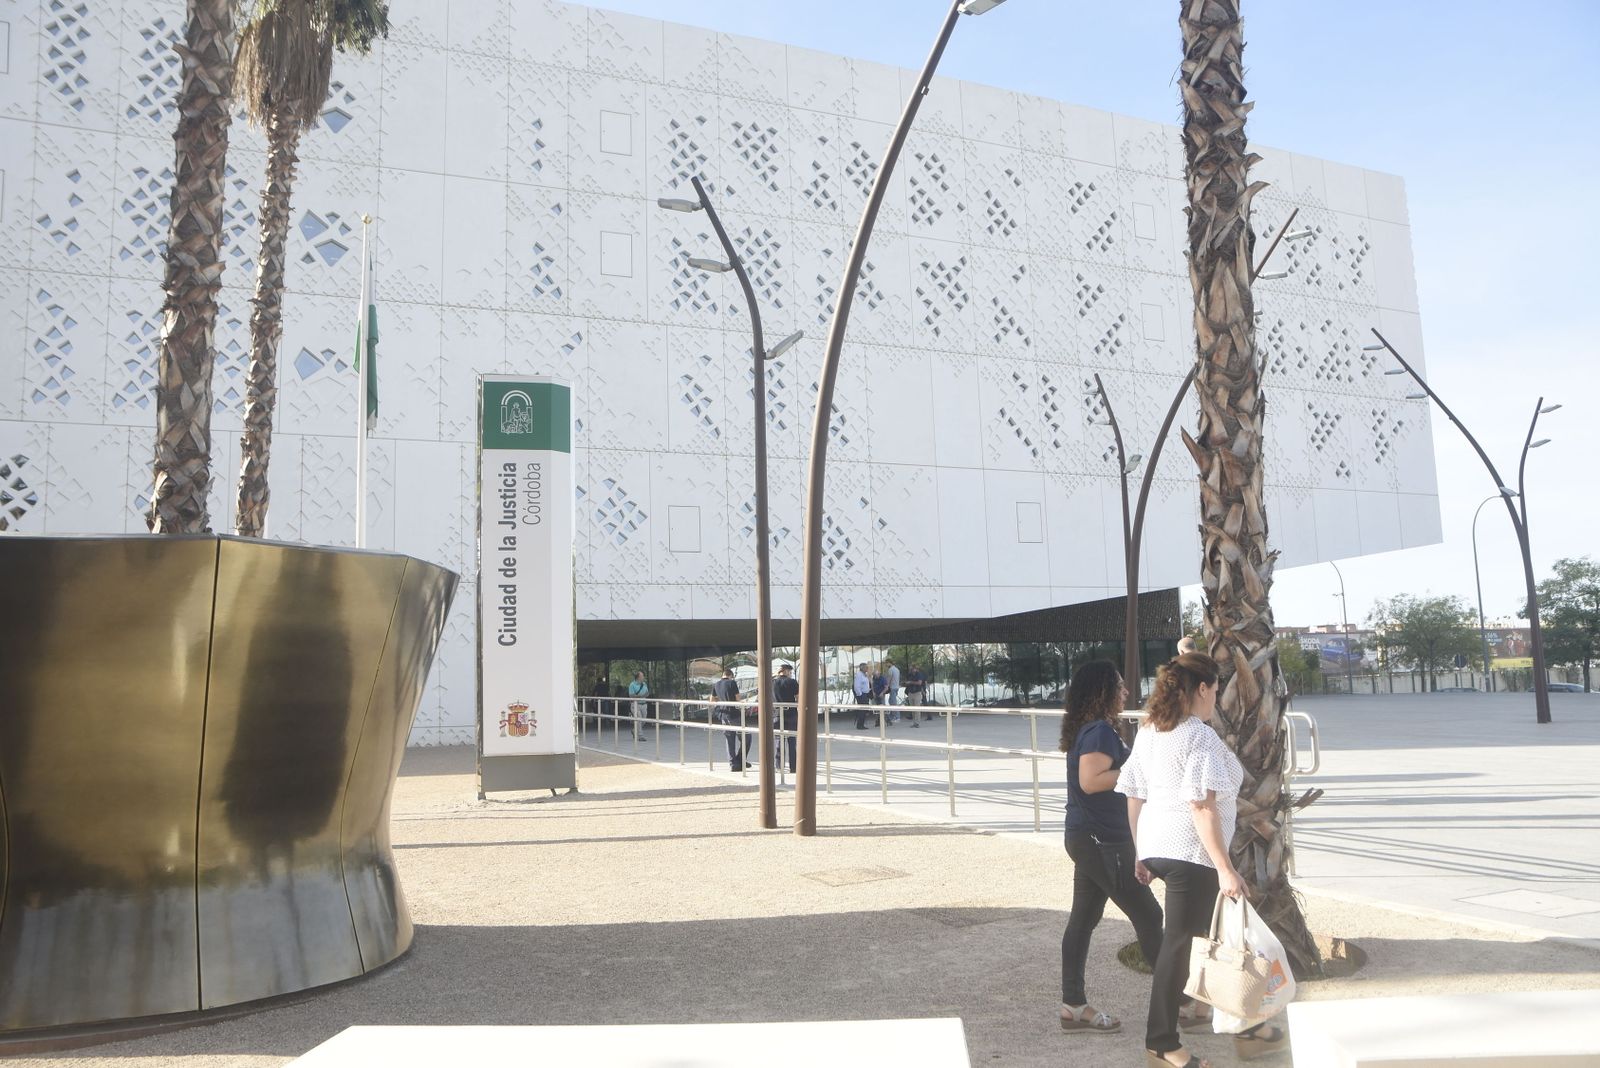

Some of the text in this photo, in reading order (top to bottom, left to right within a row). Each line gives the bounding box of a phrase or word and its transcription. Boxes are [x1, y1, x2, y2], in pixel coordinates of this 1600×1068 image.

[498, 462, 517, 647] Ciudad de la Justicia
[522, 462, 541, 525] Córdoba
